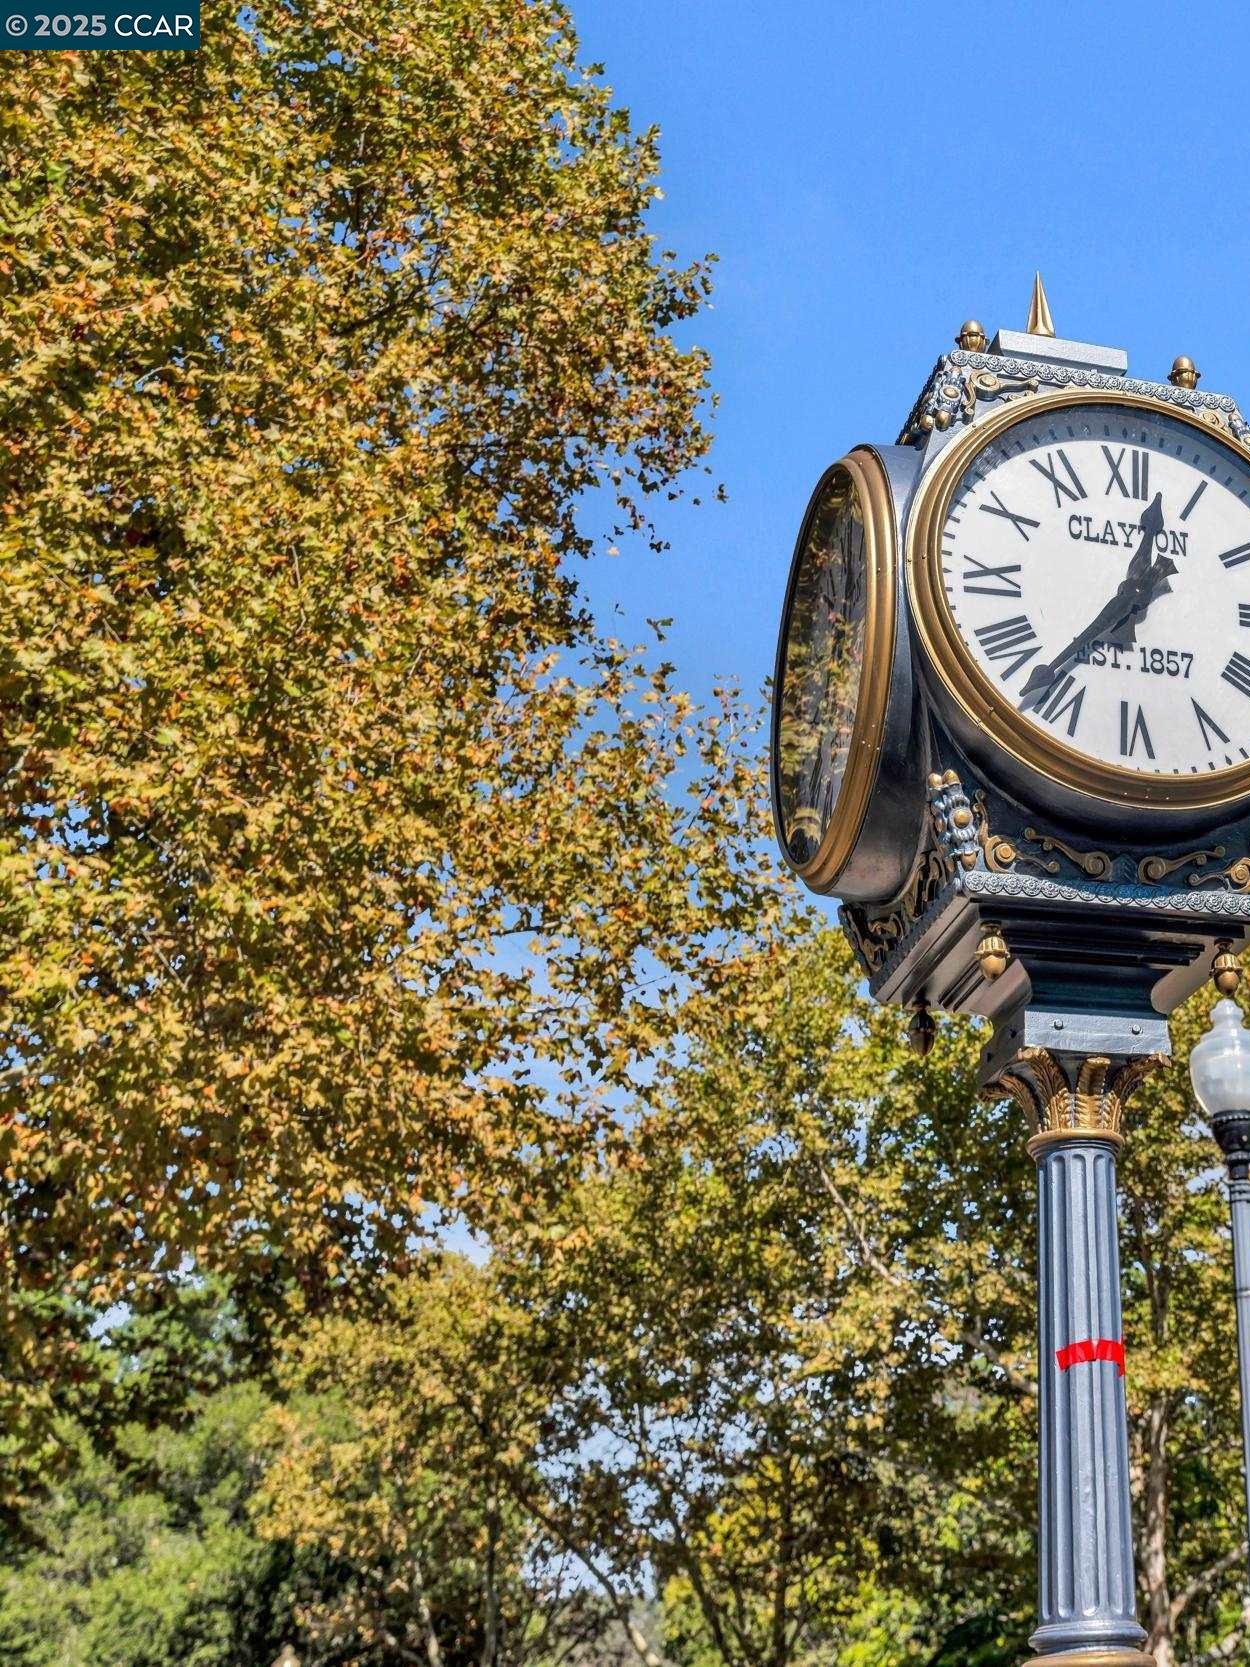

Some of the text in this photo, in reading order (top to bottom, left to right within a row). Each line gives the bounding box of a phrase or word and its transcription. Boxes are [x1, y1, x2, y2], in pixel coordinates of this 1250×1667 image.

[1030, 449, 1088, 508] XI
[1102, 445, 1149, 501] XII
[979, 491, 1040, 542] X
[963, 555, 1022, 598] IX
[974, 615, 1043, 681] VIII
[1140, 646, 1194, 679] 1857
[1120, 701, 1155, 760] VI
[1191, 697, 1230, 751] V
